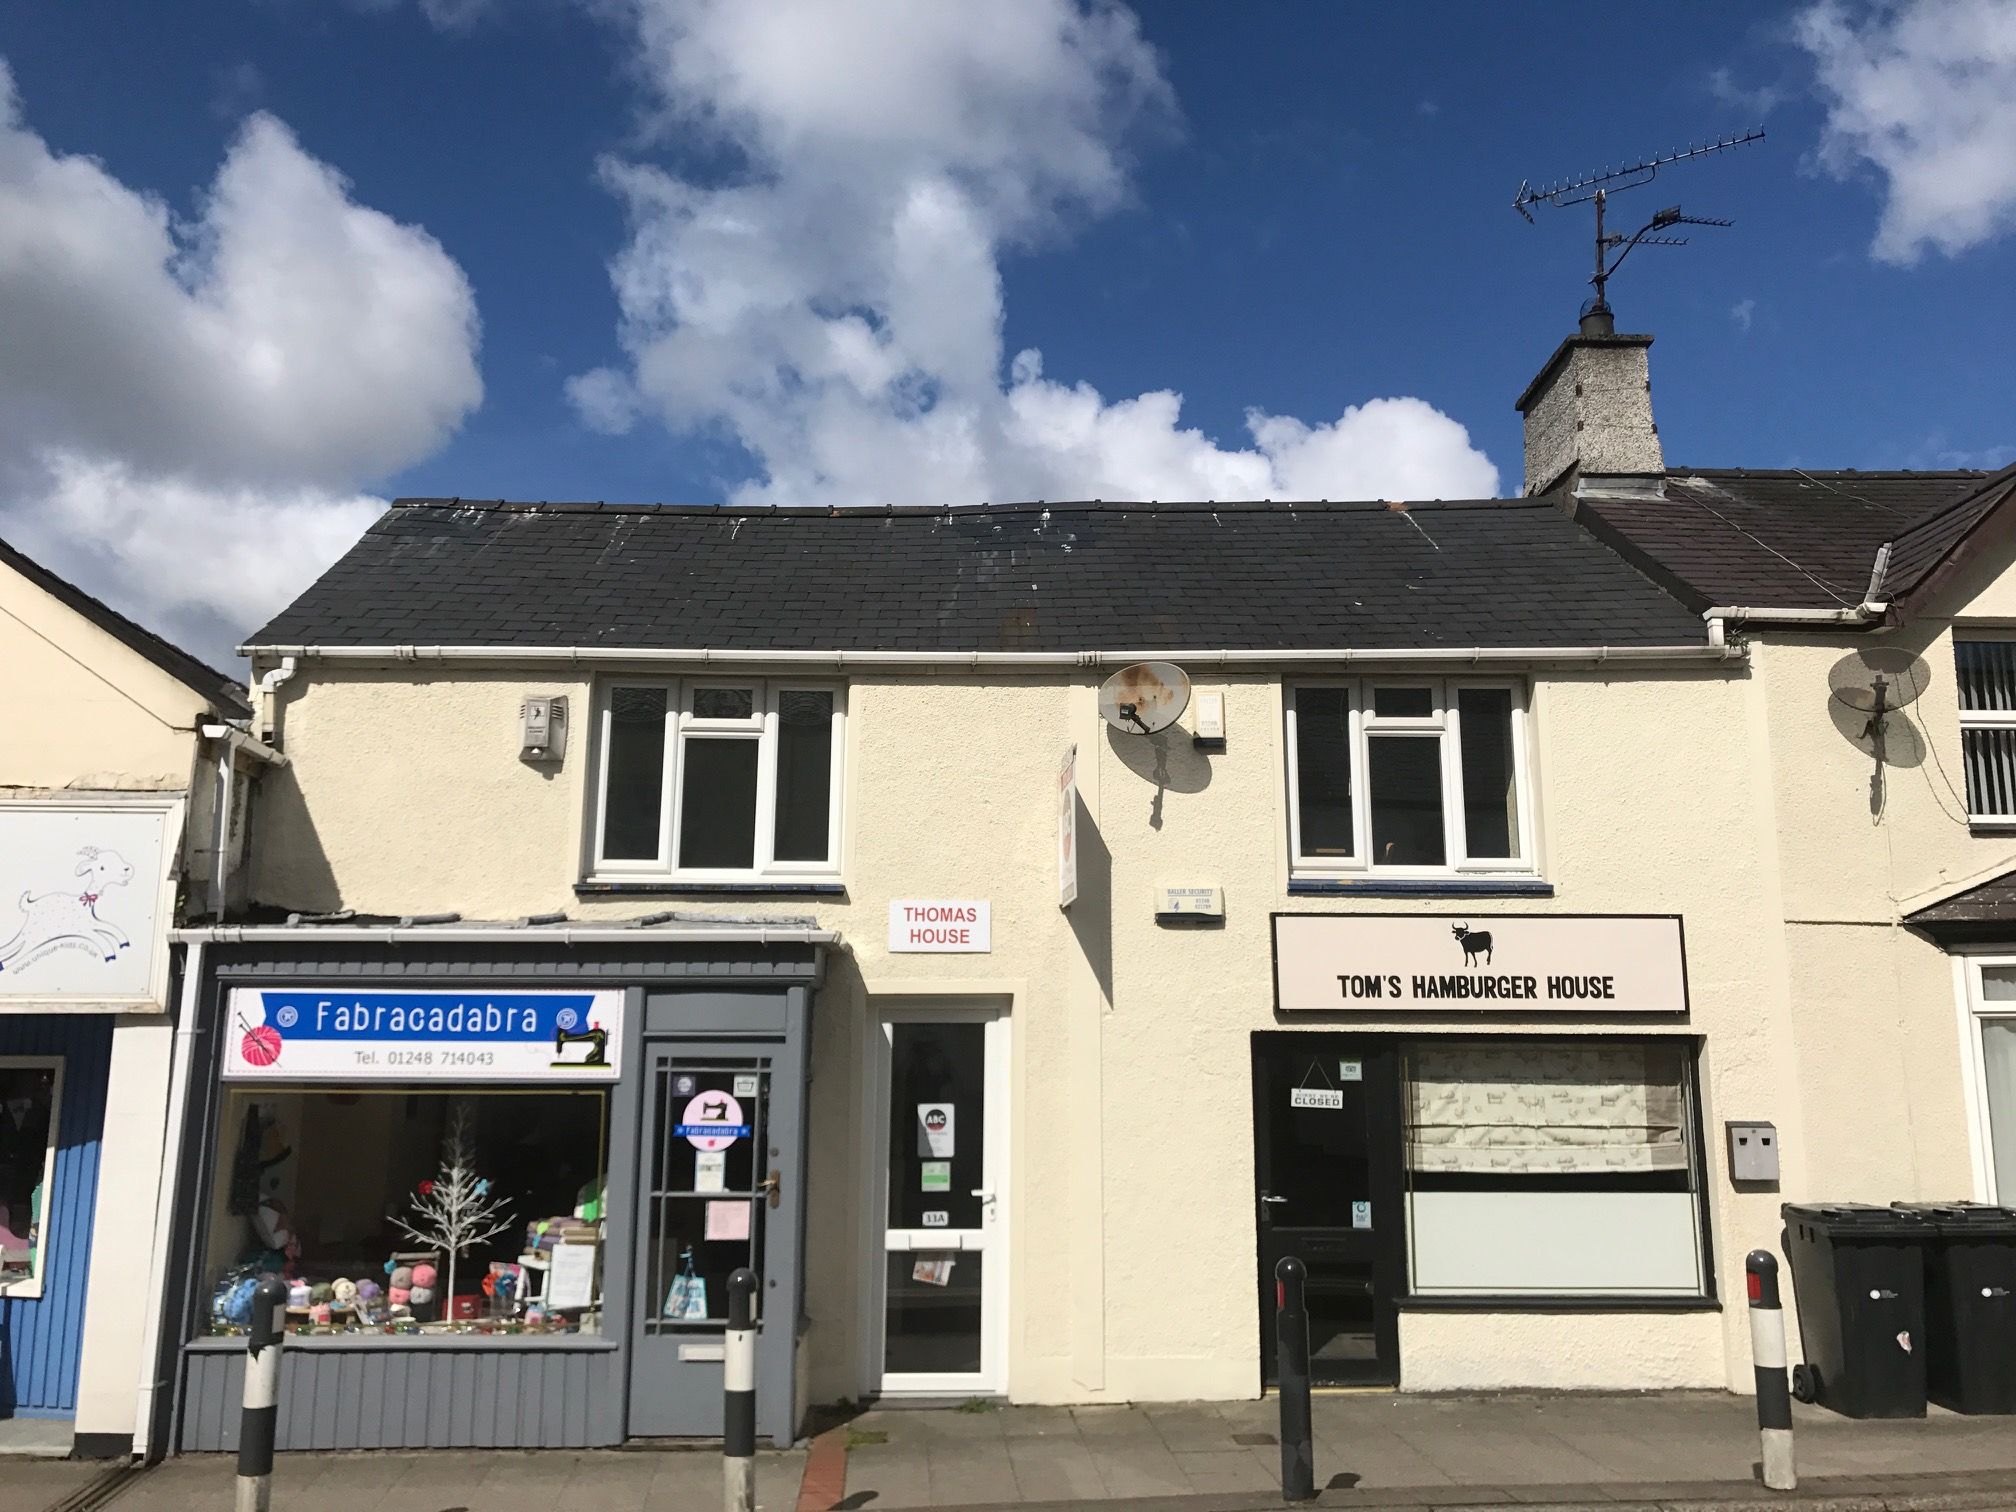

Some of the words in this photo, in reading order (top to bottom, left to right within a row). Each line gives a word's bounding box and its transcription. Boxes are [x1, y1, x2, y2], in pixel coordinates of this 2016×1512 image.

[1188, 888, 1213, 896] SECURITY
[903, 907, 977, 922] THOMAS
[910, 928, 970, 944] HOUSE
[1337, 974, 1402, 999] TOM'S
[1412, 975, 1538, 1000] HAMBURGER
[1547, 976, 1615, 1000] HOUSE
[316, 1001, 537, 1032] Fabracadabra
[354, 1050, 379, 1066] Tel.
[388, 1051, 432, 1066] 01248
[440, 1051, 494, 1066] 714043
[1294, 1097, 1340, 1107] CLOSED
[927, 1213, 945, 1223] 11A
